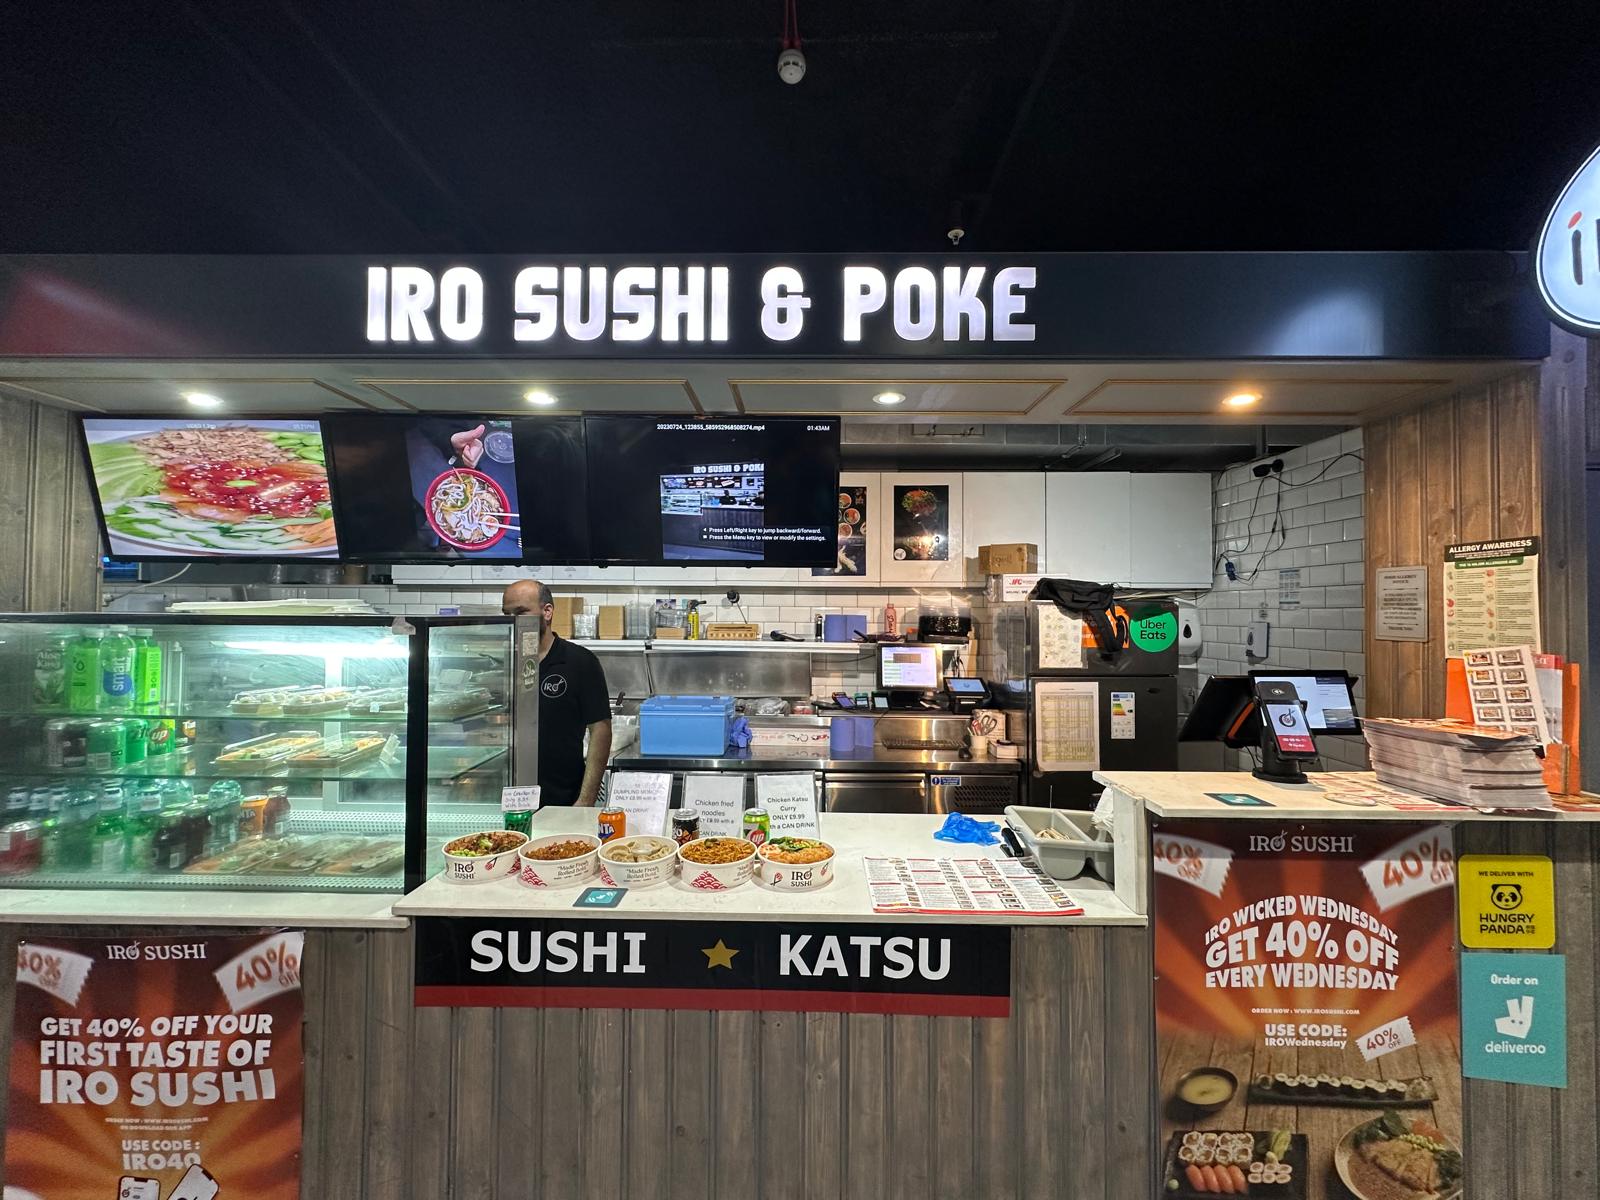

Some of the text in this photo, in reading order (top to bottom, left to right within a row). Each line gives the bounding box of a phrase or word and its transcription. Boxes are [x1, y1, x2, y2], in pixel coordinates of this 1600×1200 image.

[367, 266, 1037, 342] IRO SUSHI & POKE
[708, 464, 732, 473] SUSHI
[748, 527, 757, 535] key
[1449, 544, 1481, 554] ALLERGY
[1482, 539, 1533, 551] AWARENESS
[1140, 619, 1167, 630] Uber
[1140, 630, 1167, 641] Eats
[112, 656, 126, 692] smart
[543, 681, 561, 692] IRO
[780, 805, 797, 813] Curry
[1250, 830, 1354, 853] IRO SUSHI
[454, 861, 474, 873] IRO
[1382, 835, 1453, 889] 40%
[791, 869, 813, 880] IRO
[1205, 895, 1399, 946] IRO WICKED WEDNESDAY
[1479, 913, 1535, 923] HUNGRY
[1480, 924, 1525, 934] PANDA
[107, 941, 207, 961] IRO SUSHI
[1205, 920, 1399, 971] GET 40% OFF
[470, 930, 952, 980] SUSHI KATSU
[236, 941, 298, 992] 40%
[1205, 962, 1399, 991] EVERY WEDNESDAY
[1490, 973, 1539, 985] Order on
[41, 1013, 273, 1038] GET 40% OFF YOUR
[1265, 1024, 1347, 1037] USE CODE:
[1265, 1037, 1347, 1050] IROWednesday
[1367, 1028, 1399, 1050] 40%
[1388, 1040, 1401, 1049] OFF
[41, 1039, 272, 1068] FIRST TASTE OF
[1485, 1041, 1546, 1055] deliveroo
[40, 1068, 276, 1107] IRO SUSHI
[122, 1140, 150, 1151] USE
[151, 1140, 192, 1151] CODE
[122, 1152, 202, 1171] IRO40
